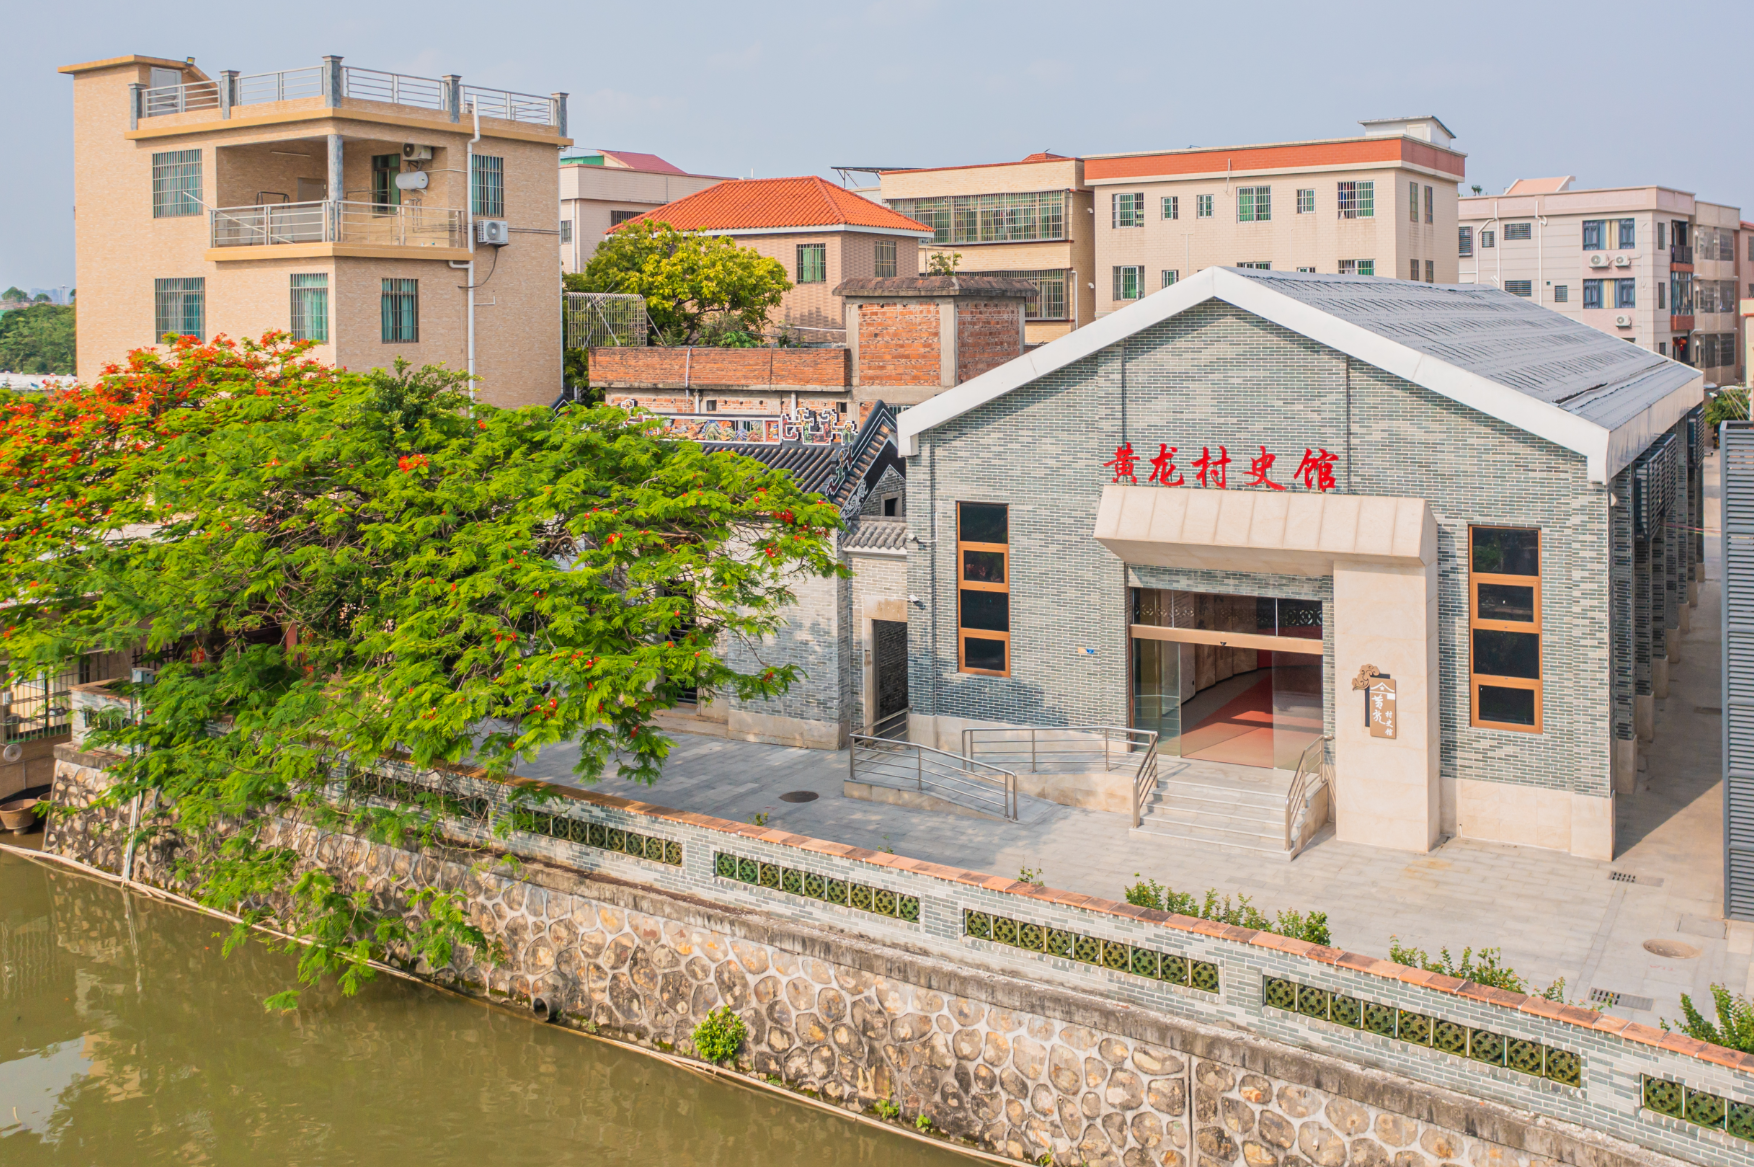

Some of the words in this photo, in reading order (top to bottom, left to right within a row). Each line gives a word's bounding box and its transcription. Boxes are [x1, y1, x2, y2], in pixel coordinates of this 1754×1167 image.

[1103, 442, 1339, 492] 黄龙村史馆
